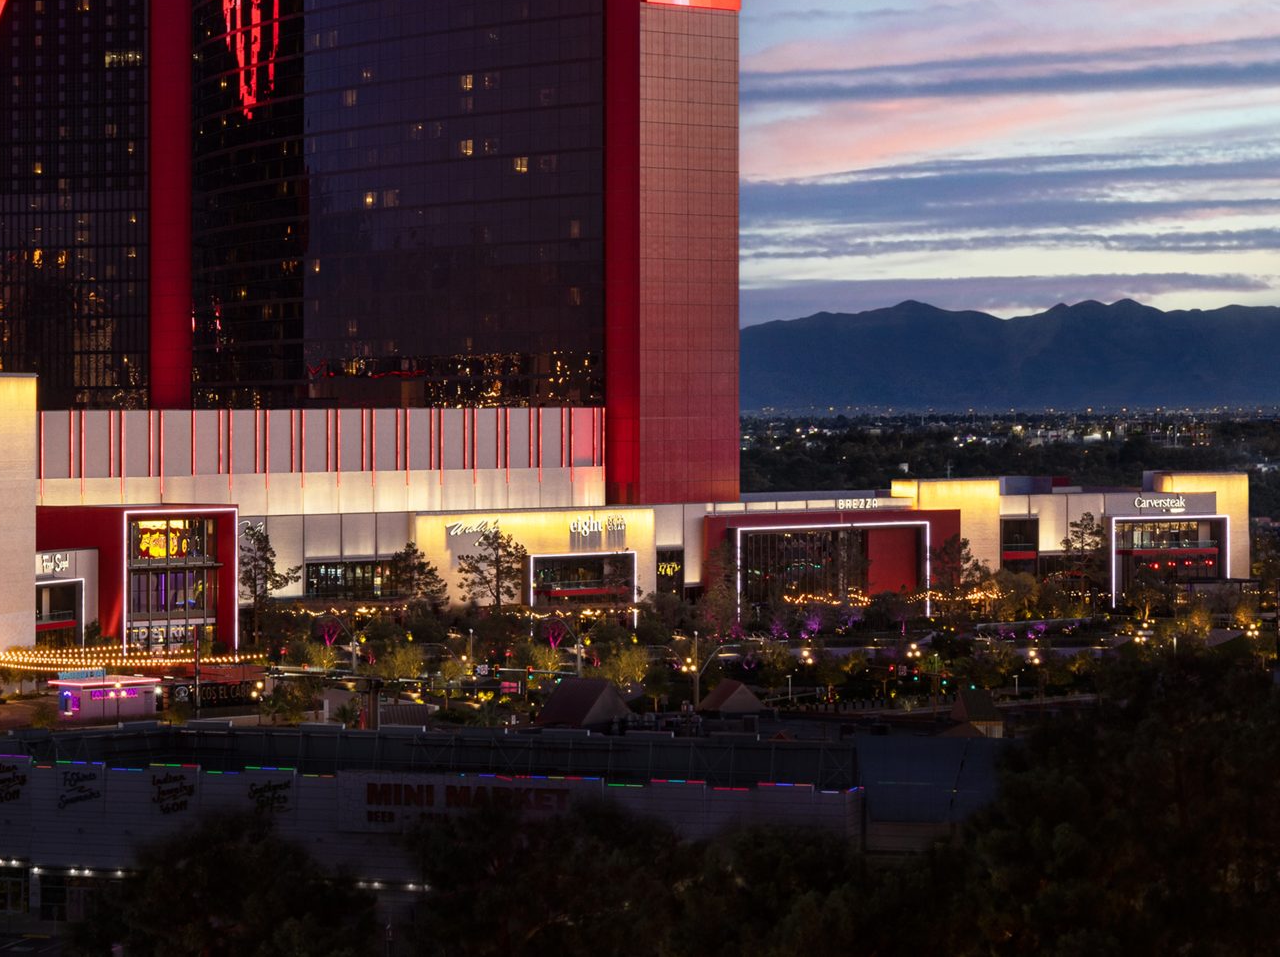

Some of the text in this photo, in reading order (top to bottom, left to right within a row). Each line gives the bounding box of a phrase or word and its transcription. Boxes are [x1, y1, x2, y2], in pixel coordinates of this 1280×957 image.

[838, 498, 878, 509] BREZZA
[1134, 496, 1186, 508] Carversteak
[570, 515, 603, 537] eight
[367, 783, 570, 811] MINI MARKET
